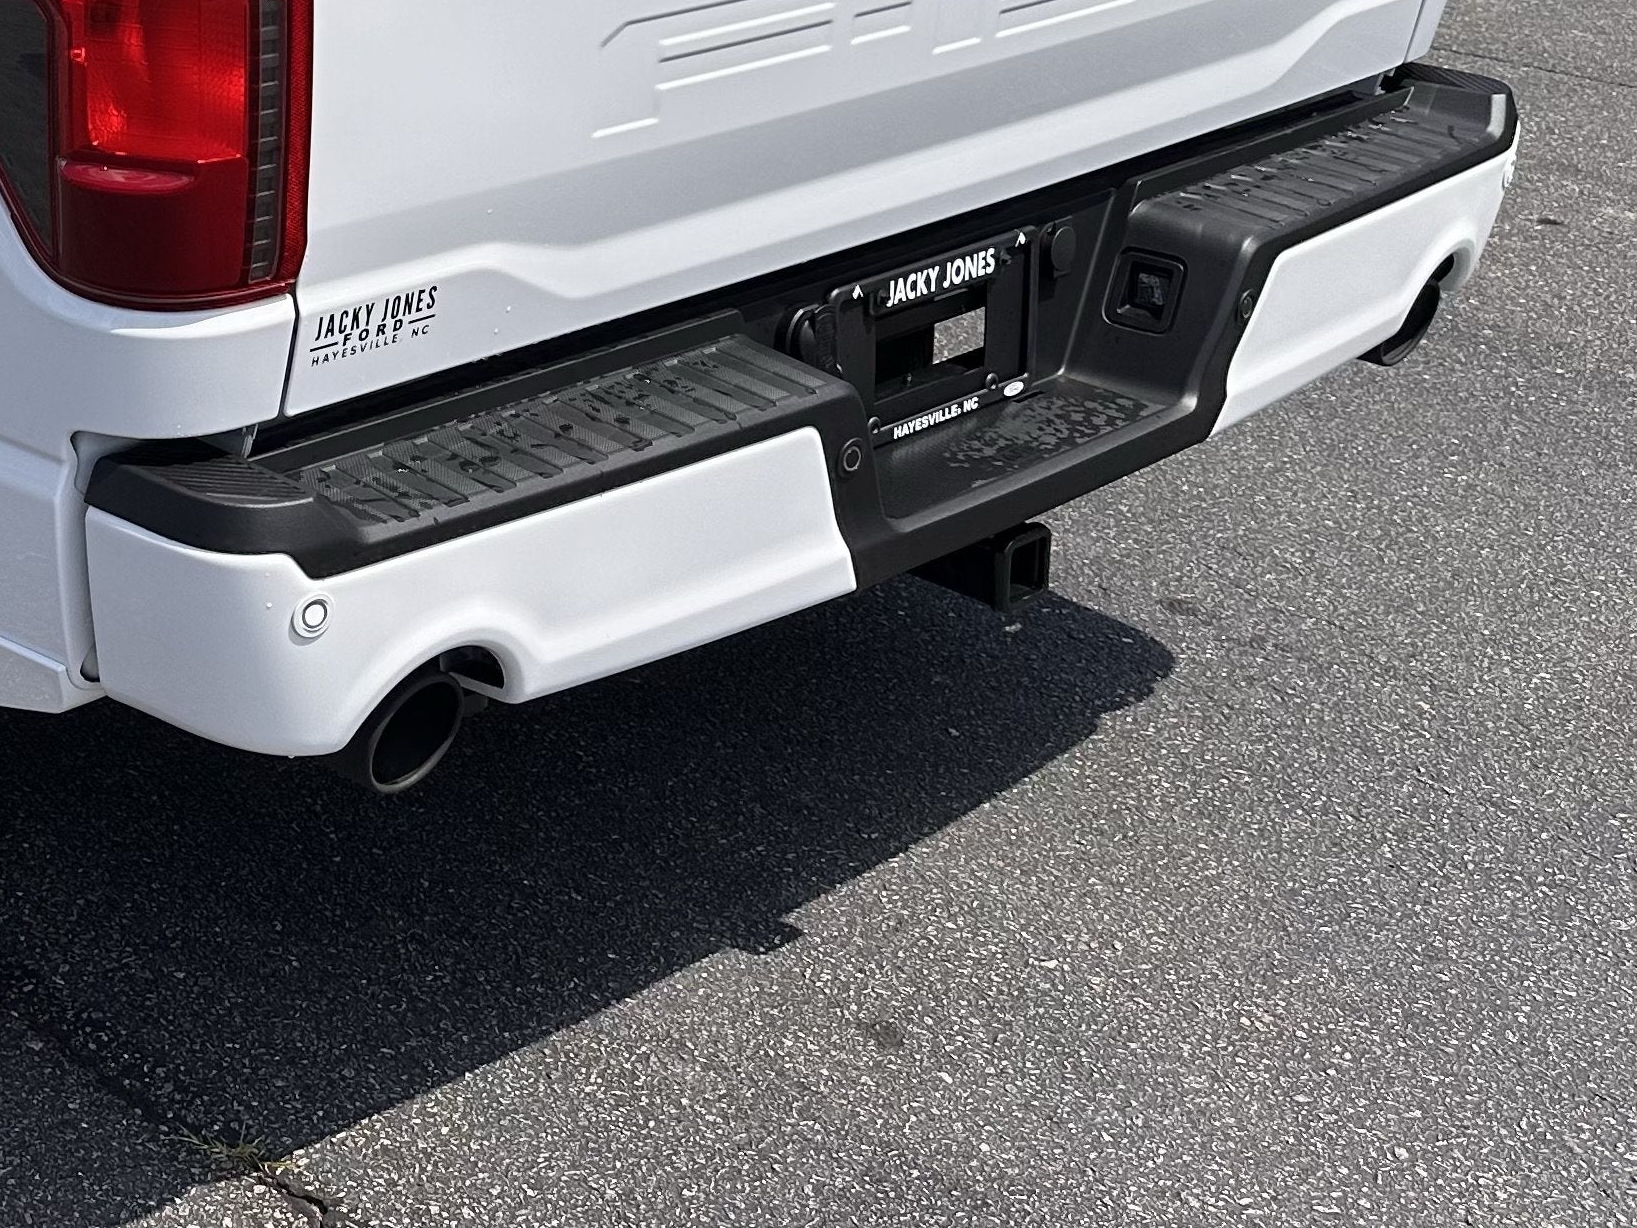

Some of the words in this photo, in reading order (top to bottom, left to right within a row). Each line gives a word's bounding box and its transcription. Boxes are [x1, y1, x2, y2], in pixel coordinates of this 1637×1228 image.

[885, 265, 940, 308] JACKY
[942, 247, 996, 289] JONES
[314, 302, 375, 342] JACKY
[381, 285, 438, 323] JONES
[342, 318, 404, 347] FORD
[411, 324, 430, 339] NC
[963, 396, 979, 413] NC
